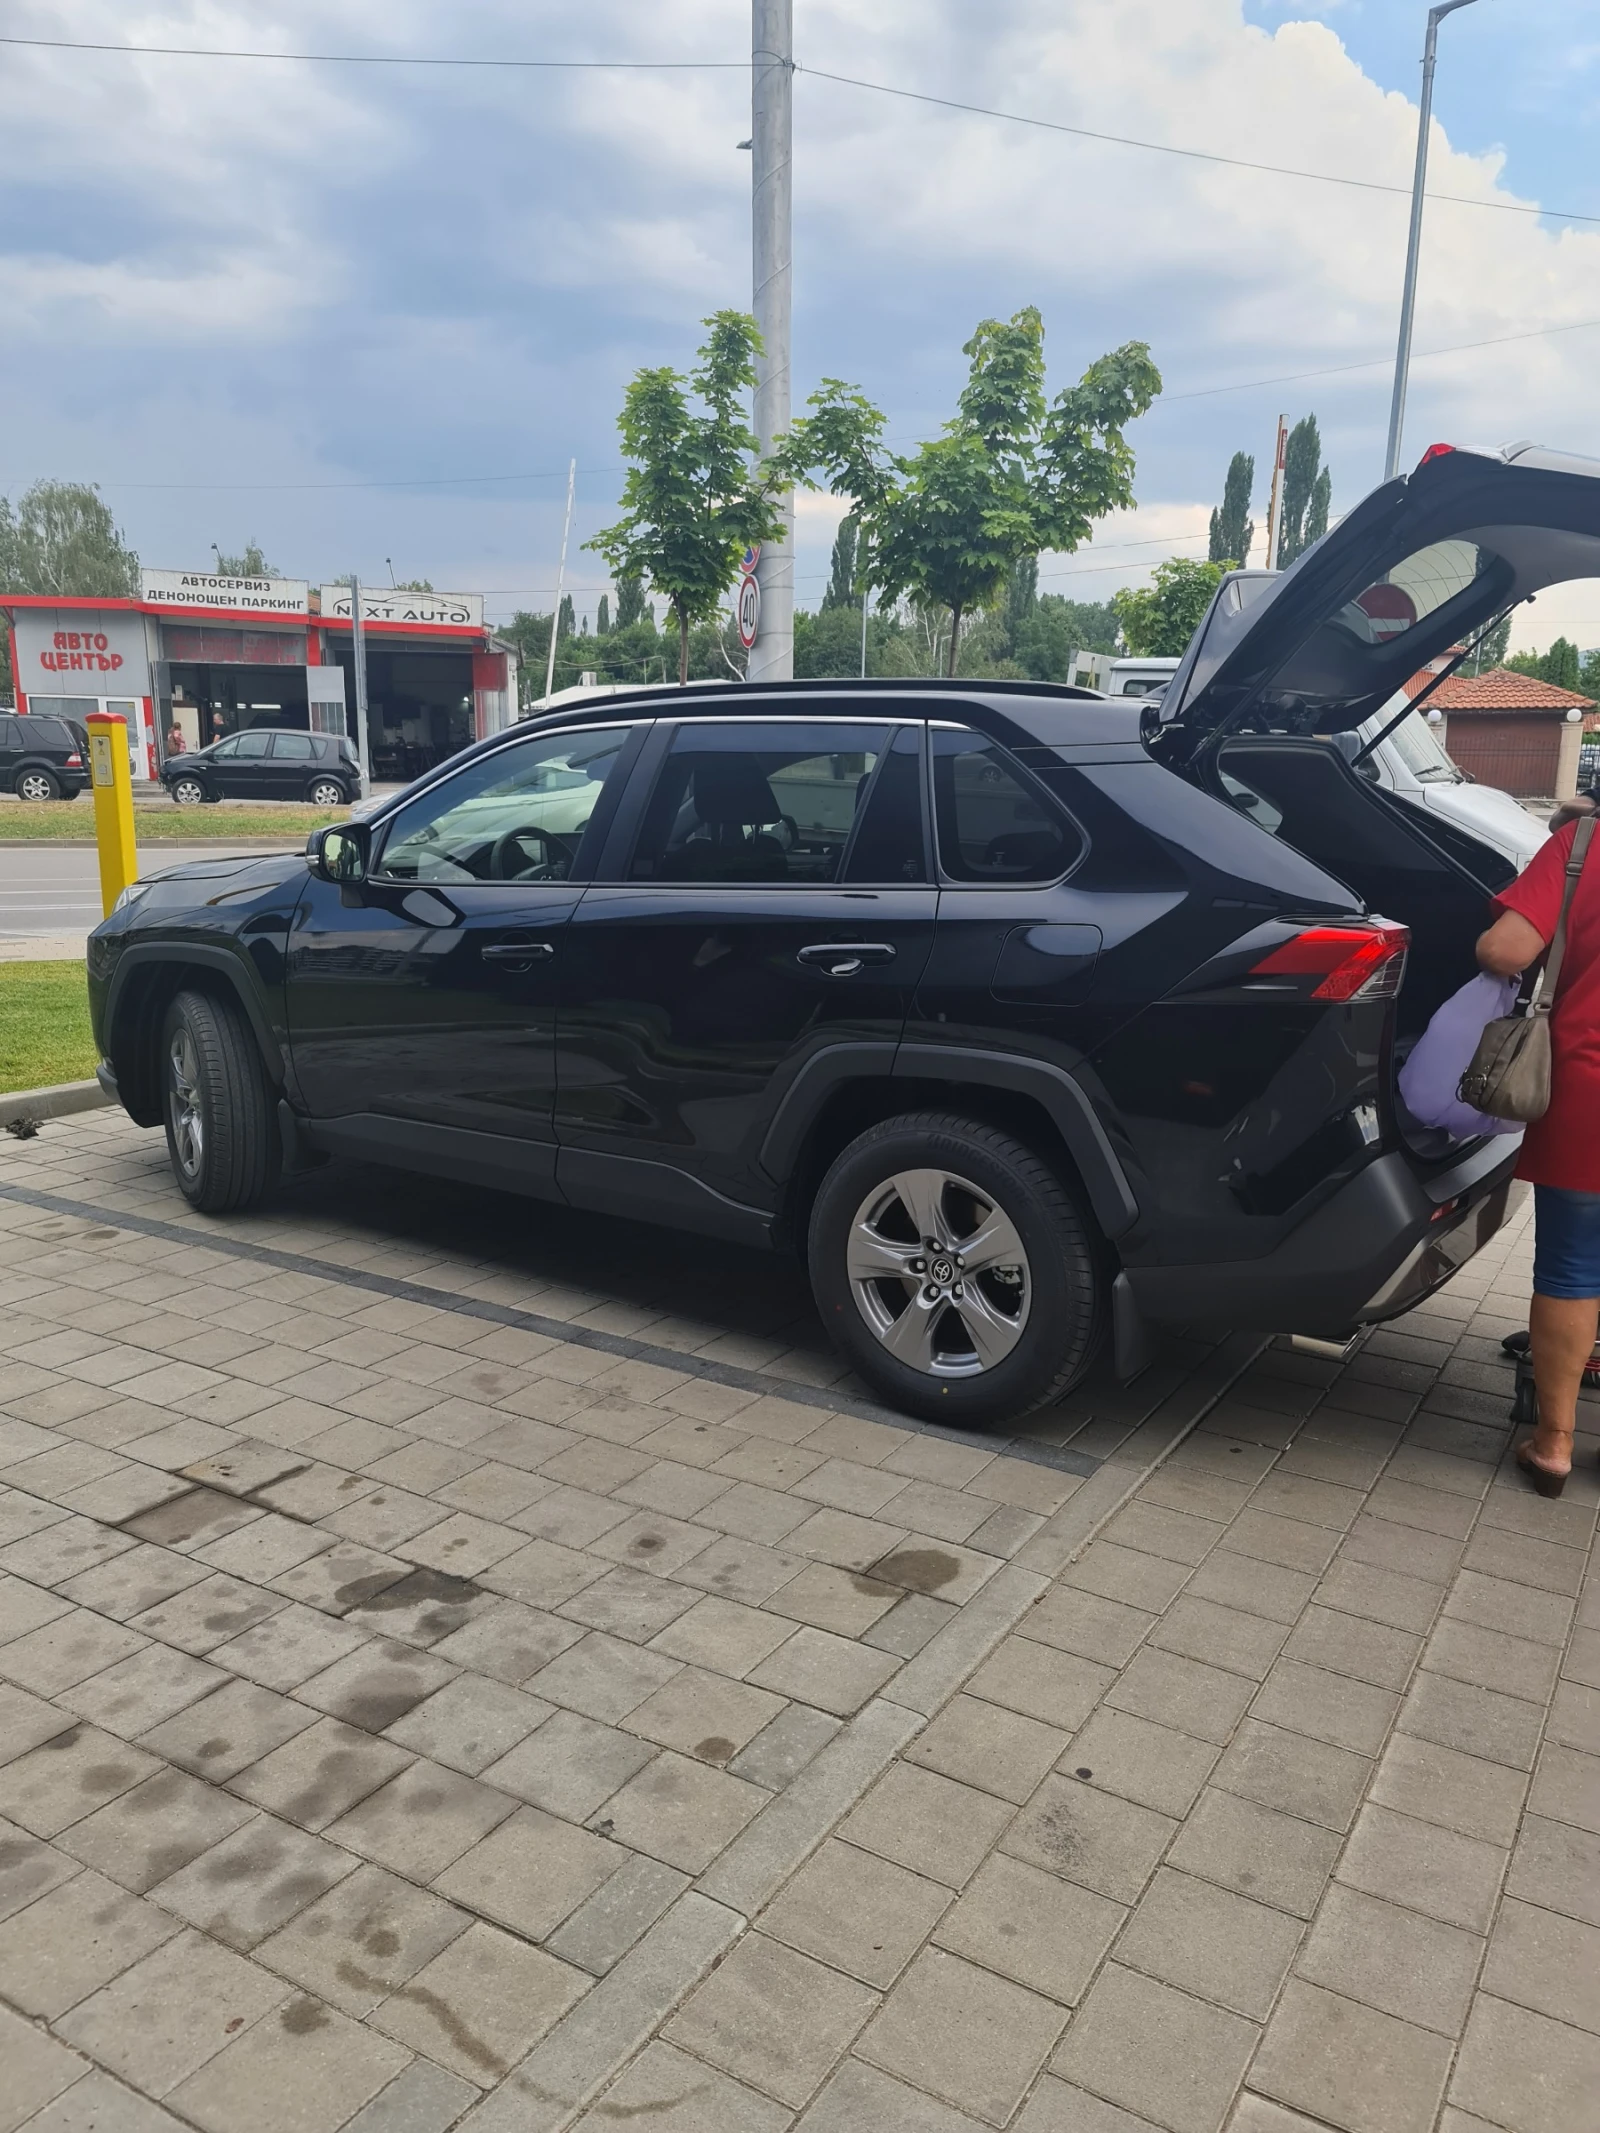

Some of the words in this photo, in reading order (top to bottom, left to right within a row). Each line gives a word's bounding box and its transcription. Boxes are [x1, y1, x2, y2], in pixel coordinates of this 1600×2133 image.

[181, 576, 271, 591] АВТОСЕРВИЗ
[147, 589, 237, 606] ДЕНОНОЩЕН
[241, 597, 304, 610] ПАРКИНГ
[336, 605, 394, 618] NXT
[402, 609, 466, 623] AUTO
[743, 594, 755, 628] 40
[53, 632, 108, 651] АВТО
[40, 652, 123, 672] ЦЕНТЪР
